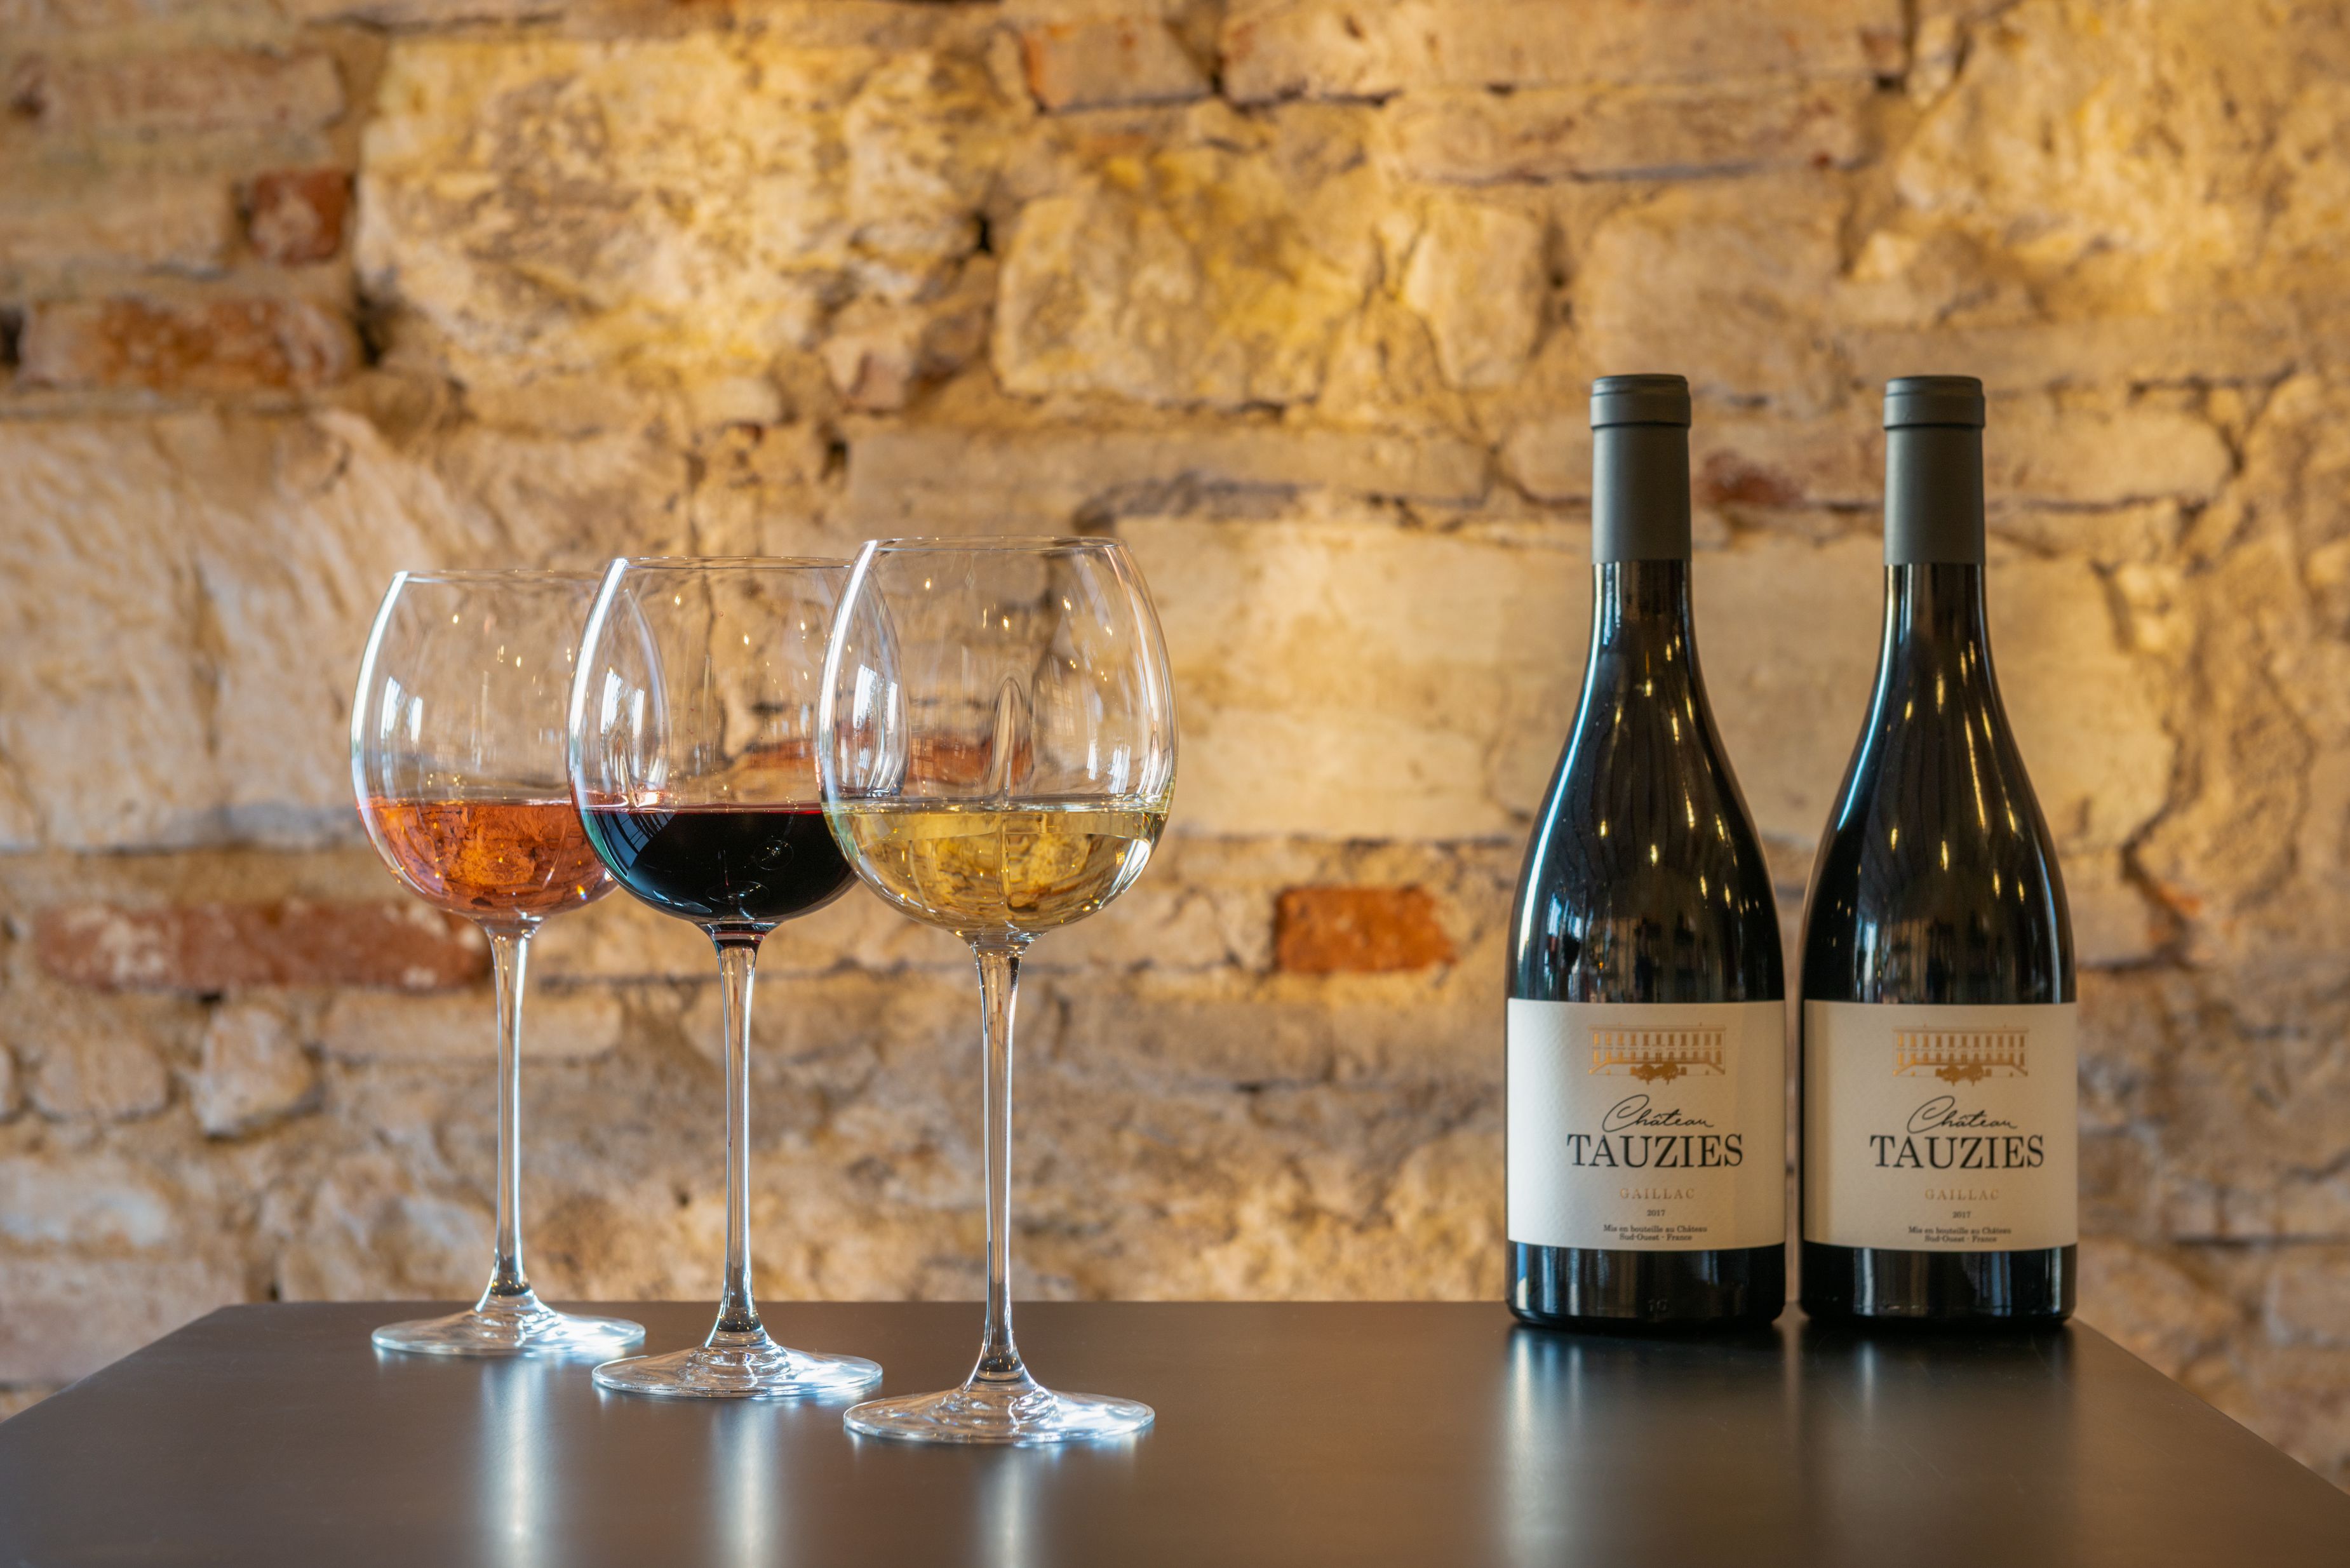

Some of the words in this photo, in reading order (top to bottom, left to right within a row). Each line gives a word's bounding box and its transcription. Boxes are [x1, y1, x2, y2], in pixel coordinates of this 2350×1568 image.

[1602, 1094, 1714, 1133] Château
[1907, 1095, 2018, 1134] Château
[1567, 1133, 1743, 1168] TAUZIES
[1869, 1134, 2044, 1169] TAUZIES
[1620, 1188, 1695, 1199] GAILLAC
[1924, 1189, 1999, 1200] GAILLAC
